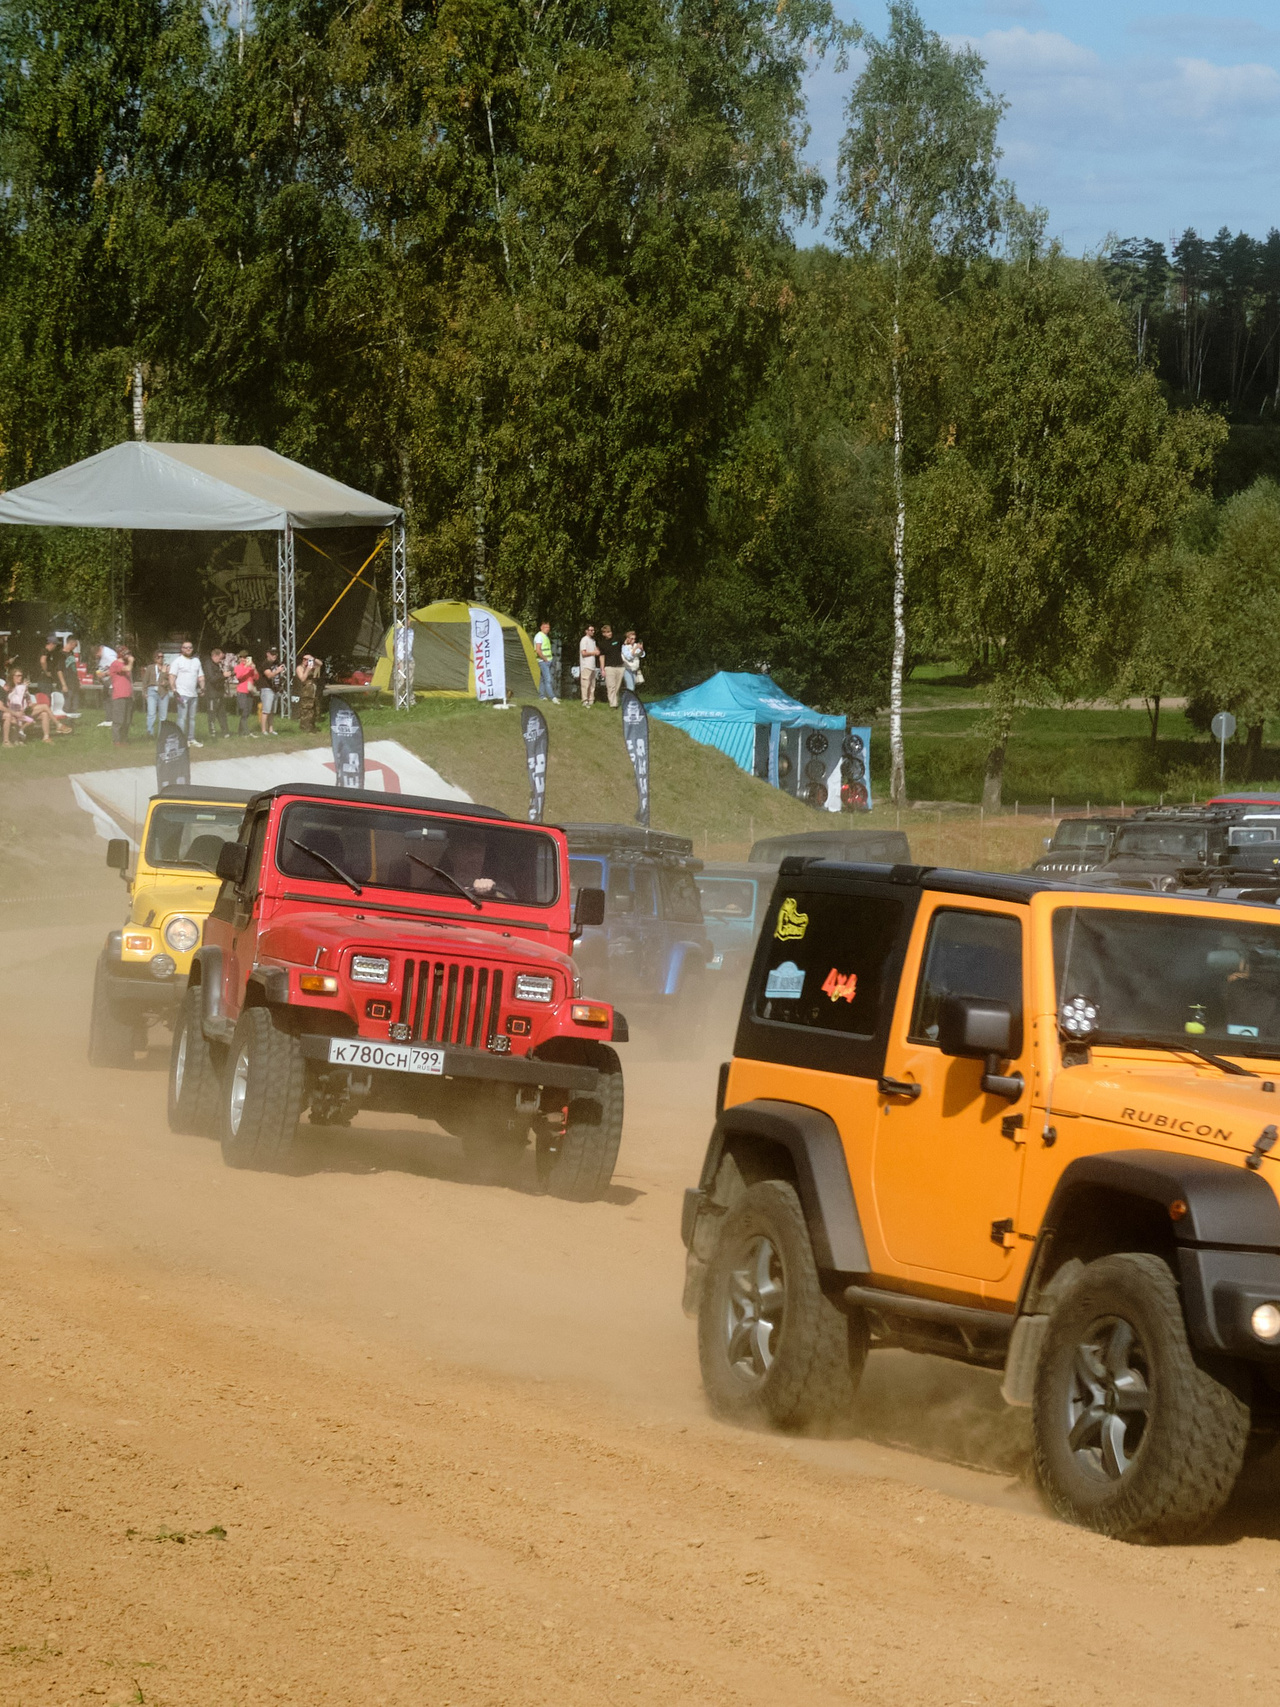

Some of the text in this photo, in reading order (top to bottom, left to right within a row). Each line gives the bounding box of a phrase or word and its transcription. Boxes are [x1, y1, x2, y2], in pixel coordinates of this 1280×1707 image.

[475, 641, 487, 698] TANK
[484, 639, 494, 697] CUSTOM
[335, 1044, 439, 1068] К780СН 799
[1120, 1107, 1233, 1141] RUBICON
